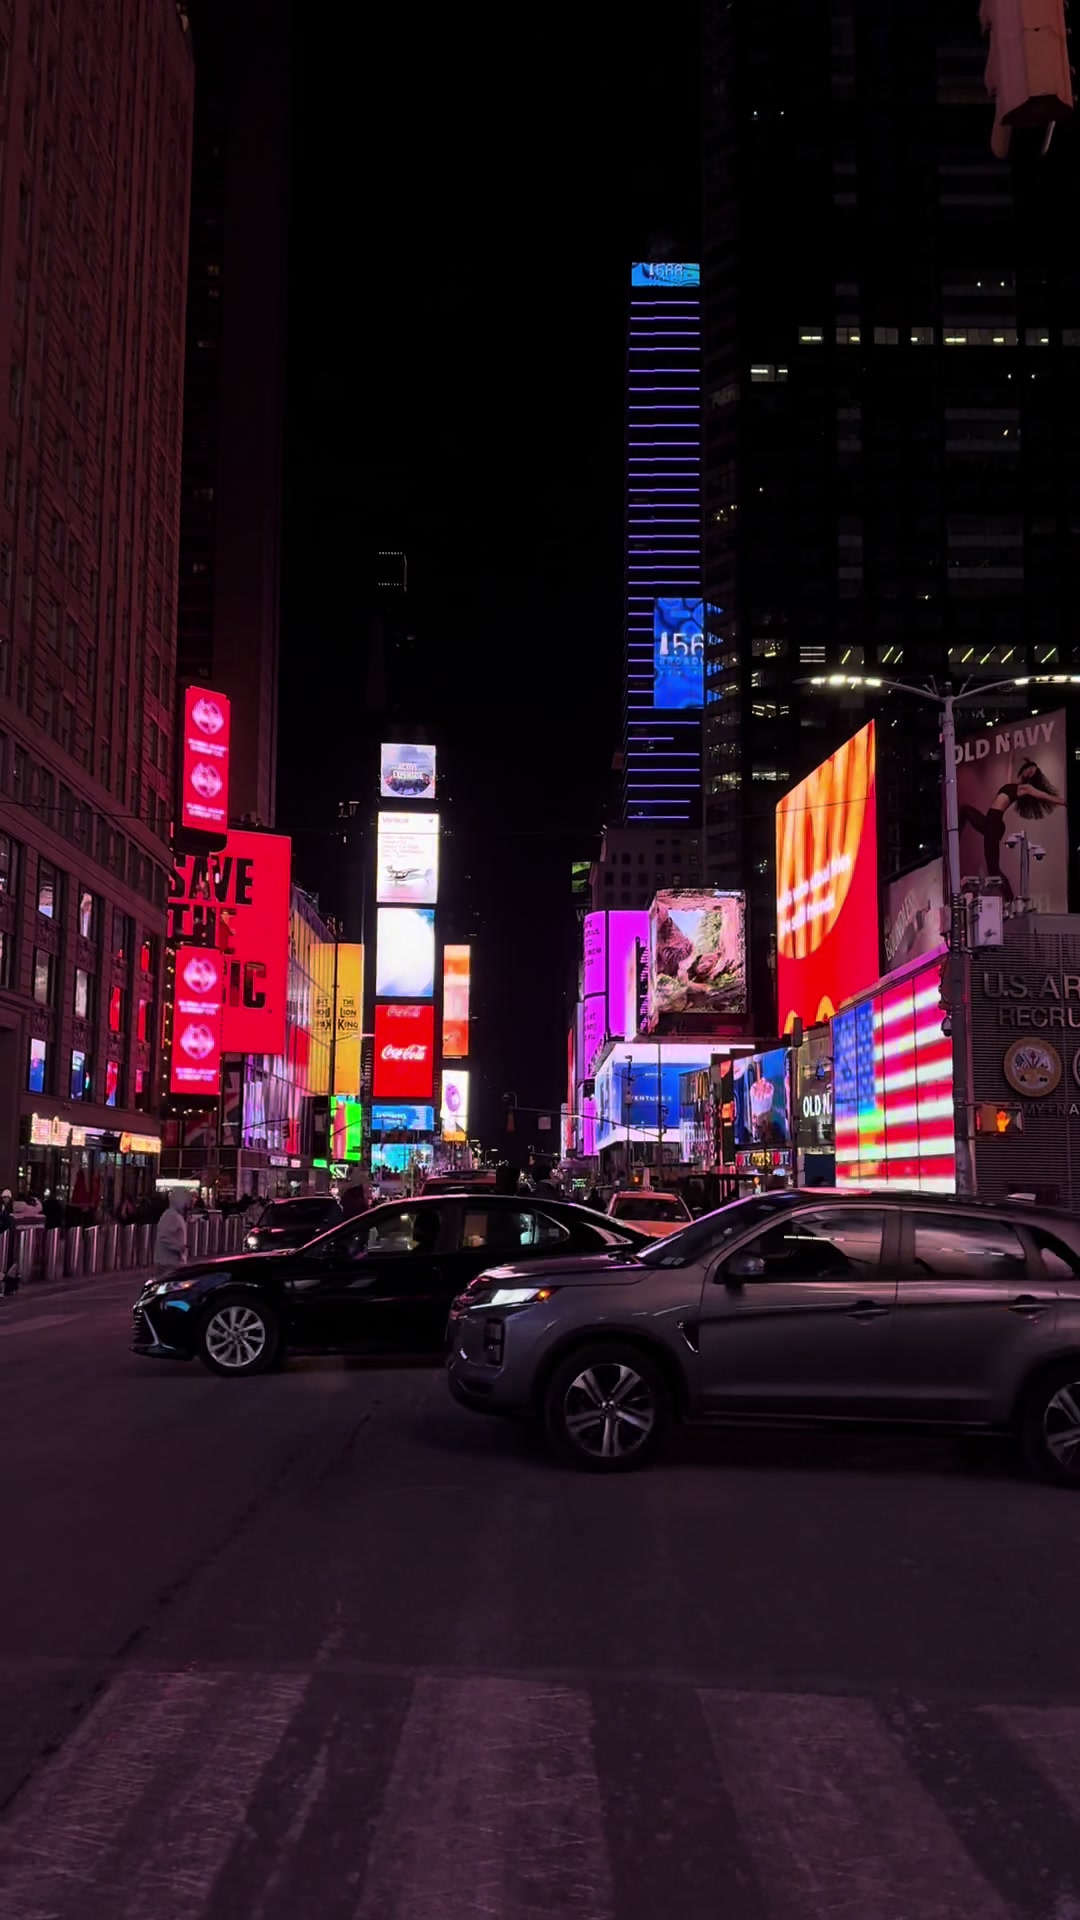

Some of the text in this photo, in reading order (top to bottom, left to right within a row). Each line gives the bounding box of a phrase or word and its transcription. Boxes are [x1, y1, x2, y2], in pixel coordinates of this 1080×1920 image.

[660, 632, 704, 655] 156
[660, 657, 704, 666] BROAD
[954, 721, 1055, 765] OLD NAVY
[167, 855, 254, 906] SAVE
[1039, 973, 1080, 999] AR
[999, 1006, 1080, 1028] RECRU
[381, 1044, 427, 1060] Coca-Cola
[803, 1095, 821, 1117] OLD
